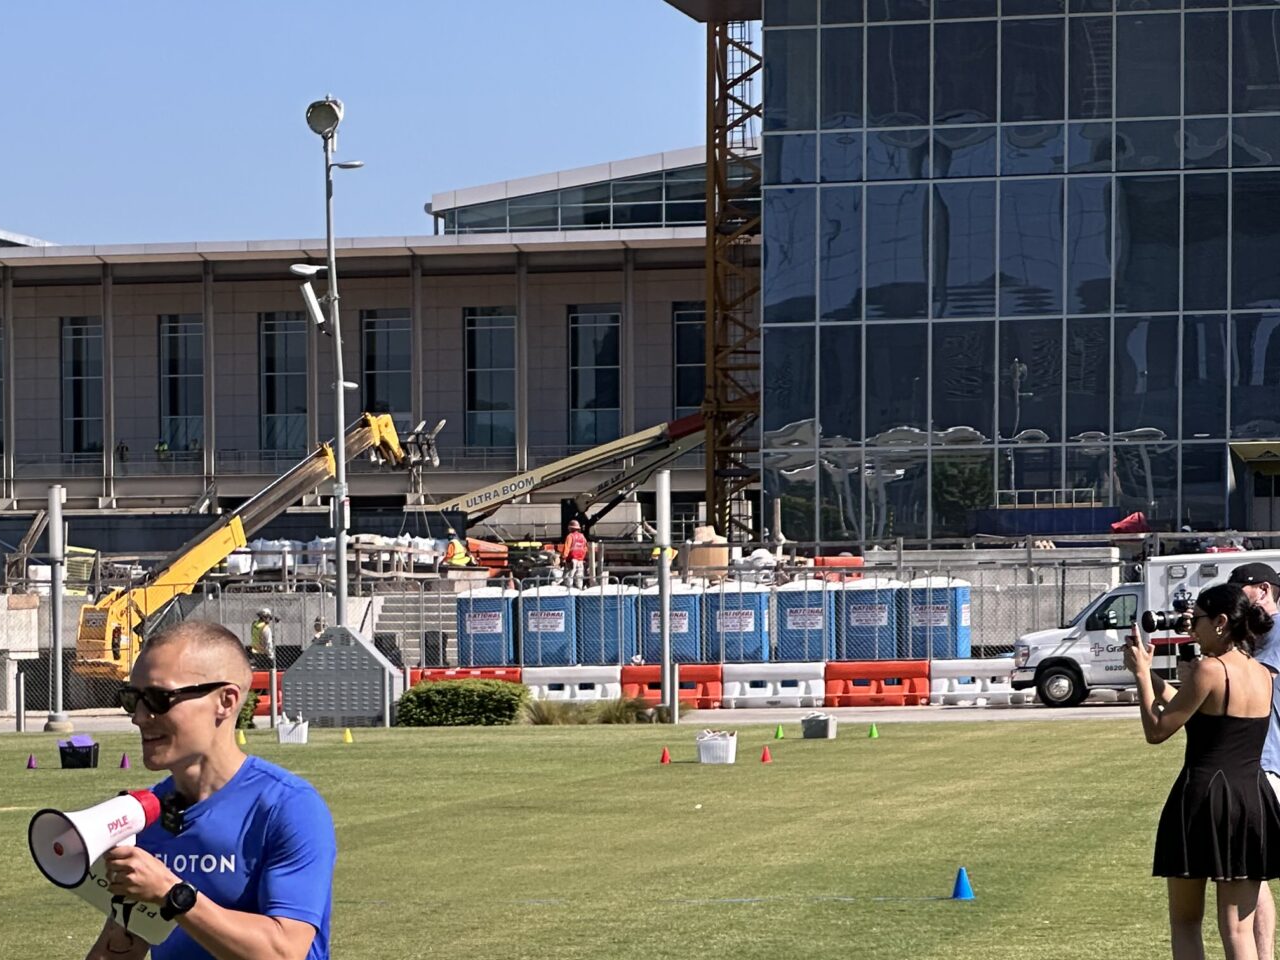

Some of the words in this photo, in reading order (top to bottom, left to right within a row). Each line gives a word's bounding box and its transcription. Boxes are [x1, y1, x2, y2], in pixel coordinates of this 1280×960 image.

[466, 490, 499, 508] ULTRA
[502, 476, 535, 496] BOOM
[1174, 592, 1193, 600] 532
[155, 853, 236, 873] LOTON
